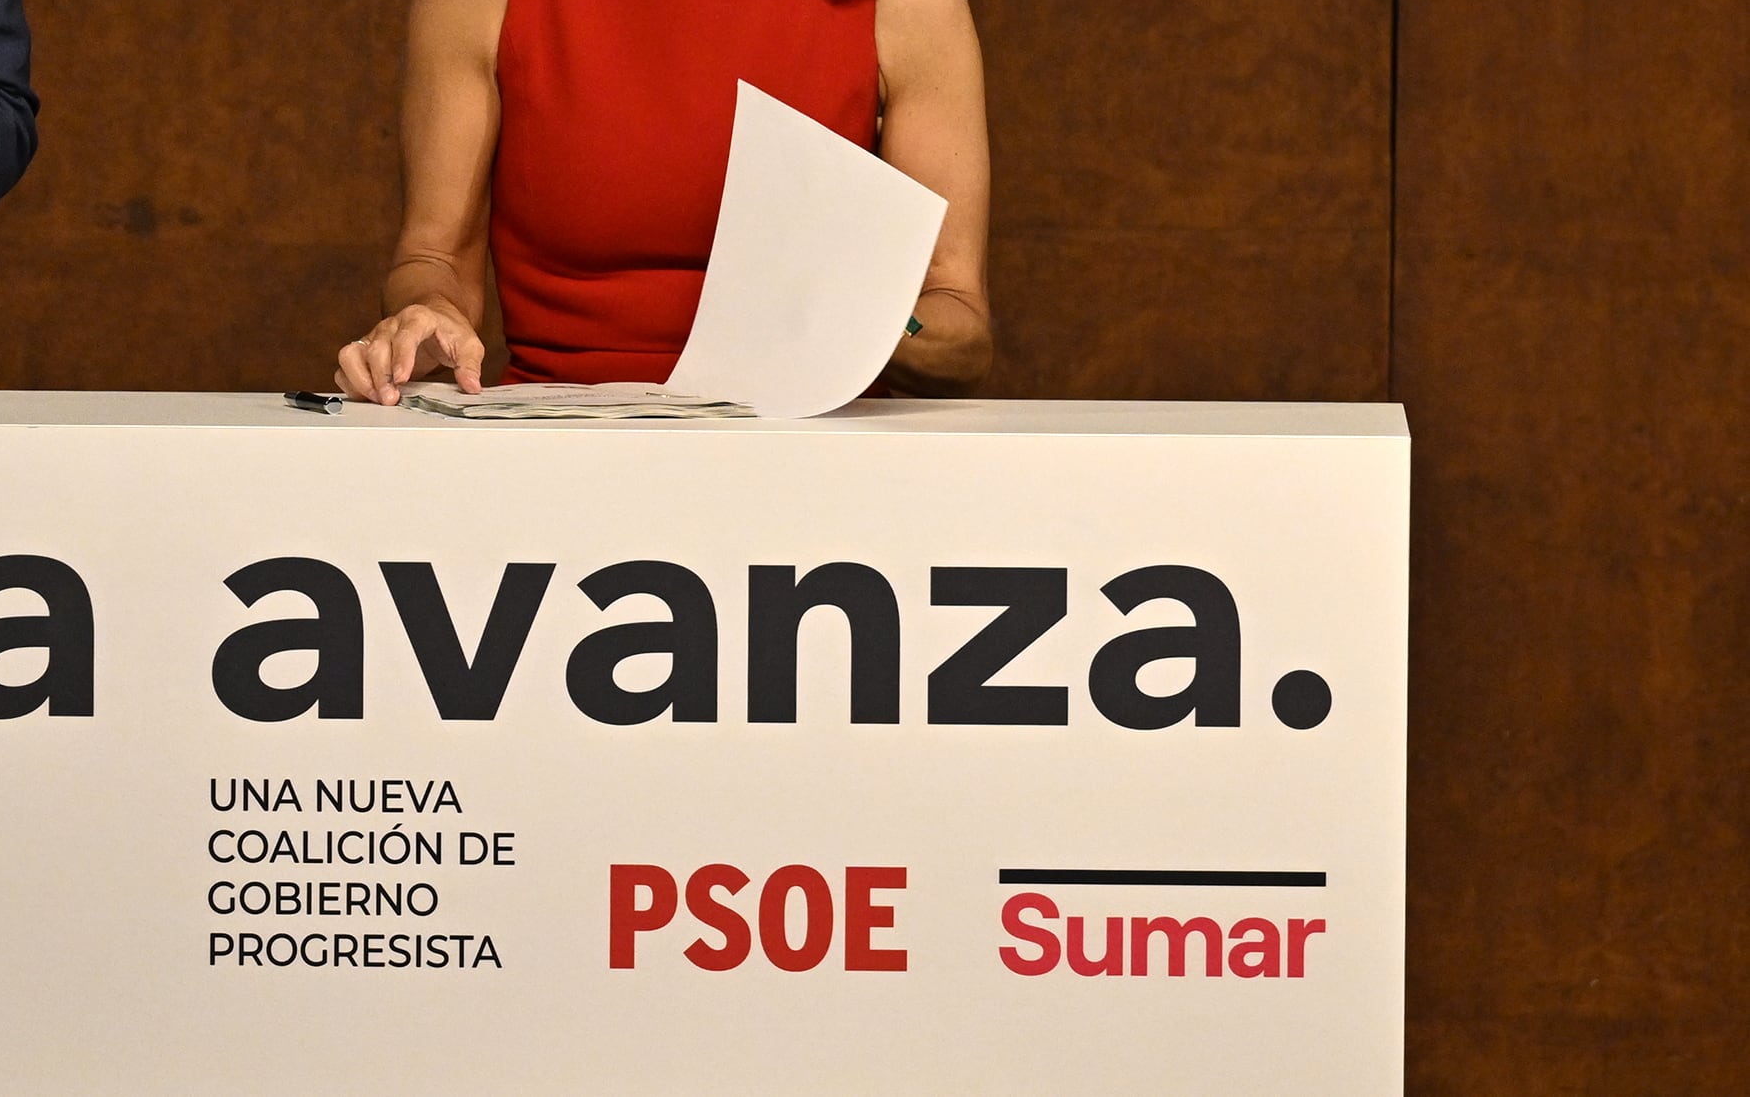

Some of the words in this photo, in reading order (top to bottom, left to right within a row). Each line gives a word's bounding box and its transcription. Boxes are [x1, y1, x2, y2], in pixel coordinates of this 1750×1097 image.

[211, 556, 1333, 731] avanza.
[210, 778, 303, 813] UNA
[316, 779, 463, 814] NUEVA
[207, 822, 442, 865] COALICIÓN
[459, 831, 516, 866] DE
[207, 880, 439, 917] GOBIERNO
[609, 863, 908, 973] PSOE
[209, 932, 503, 969] PROGRESISTA
[998, 892, 1327, 979] Sumar
